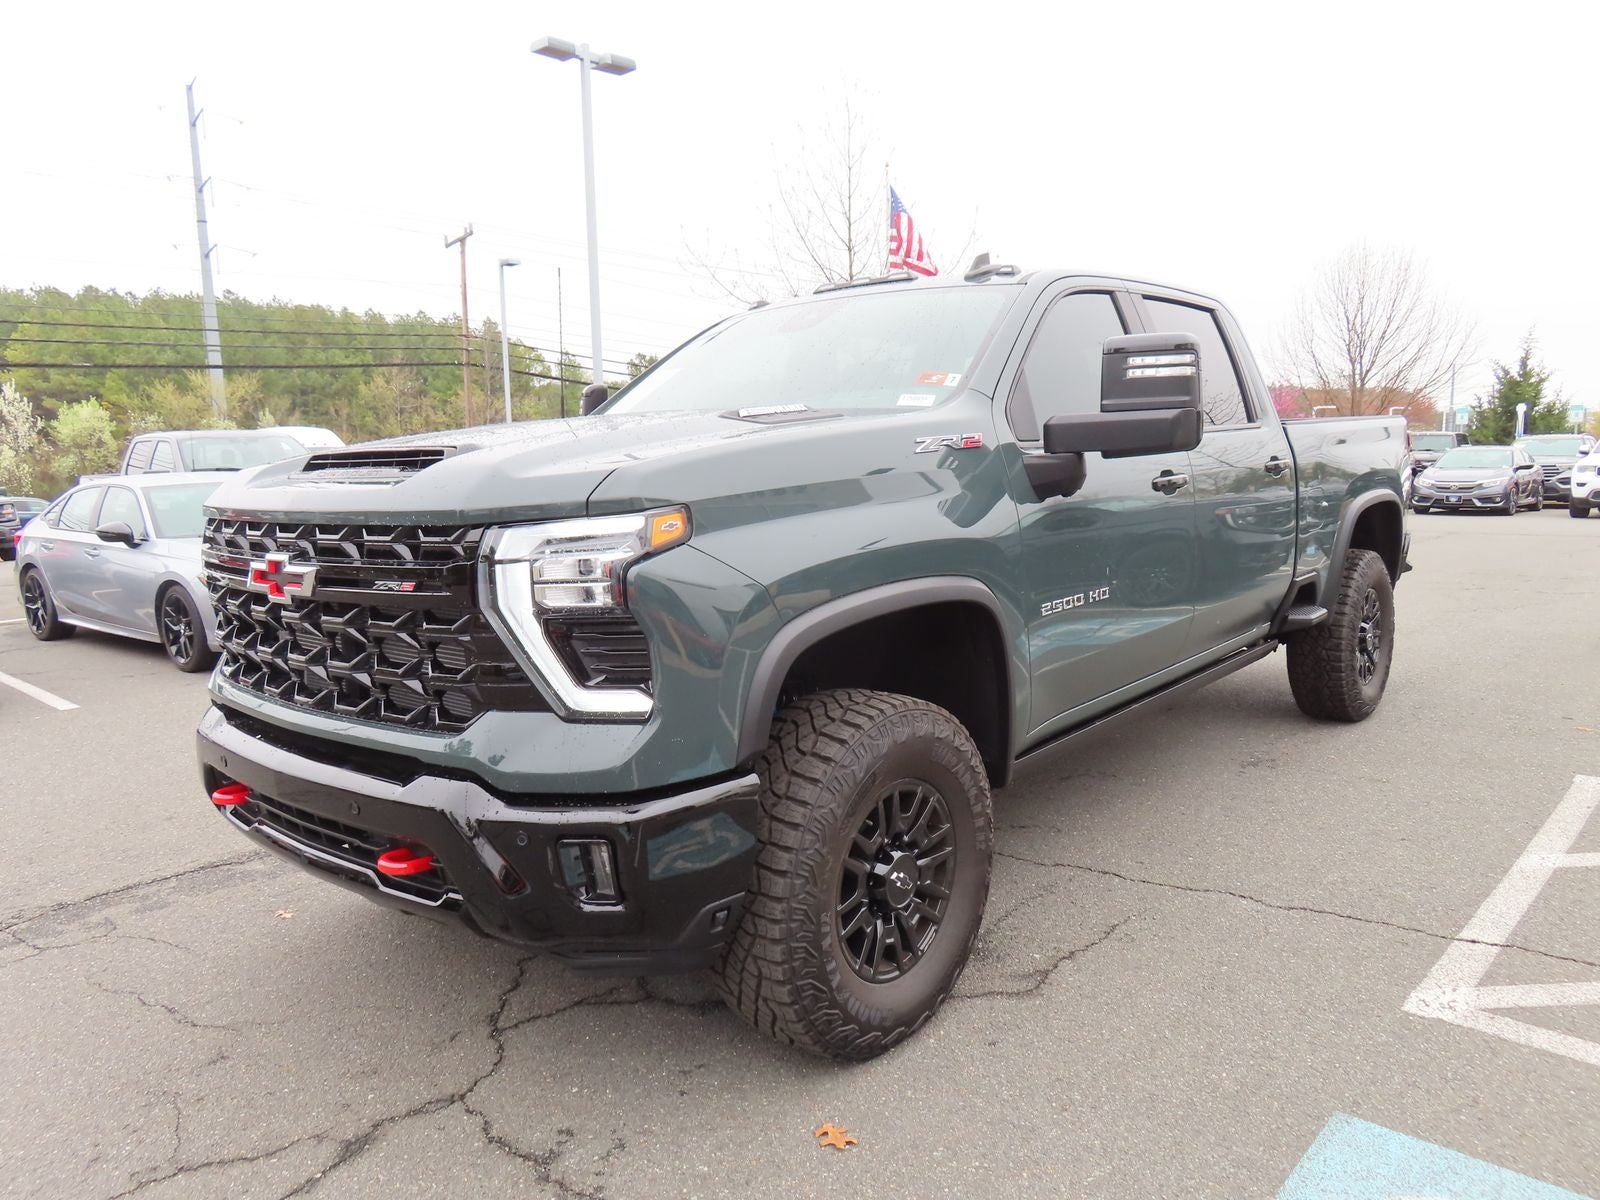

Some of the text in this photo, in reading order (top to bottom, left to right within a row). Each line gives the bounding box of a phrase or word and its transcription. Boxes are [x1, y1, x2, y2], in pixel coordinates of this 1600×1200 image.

[914, 432, 983, 454] ZR2
[1040, 587, 1110, 616] 2500 HD
